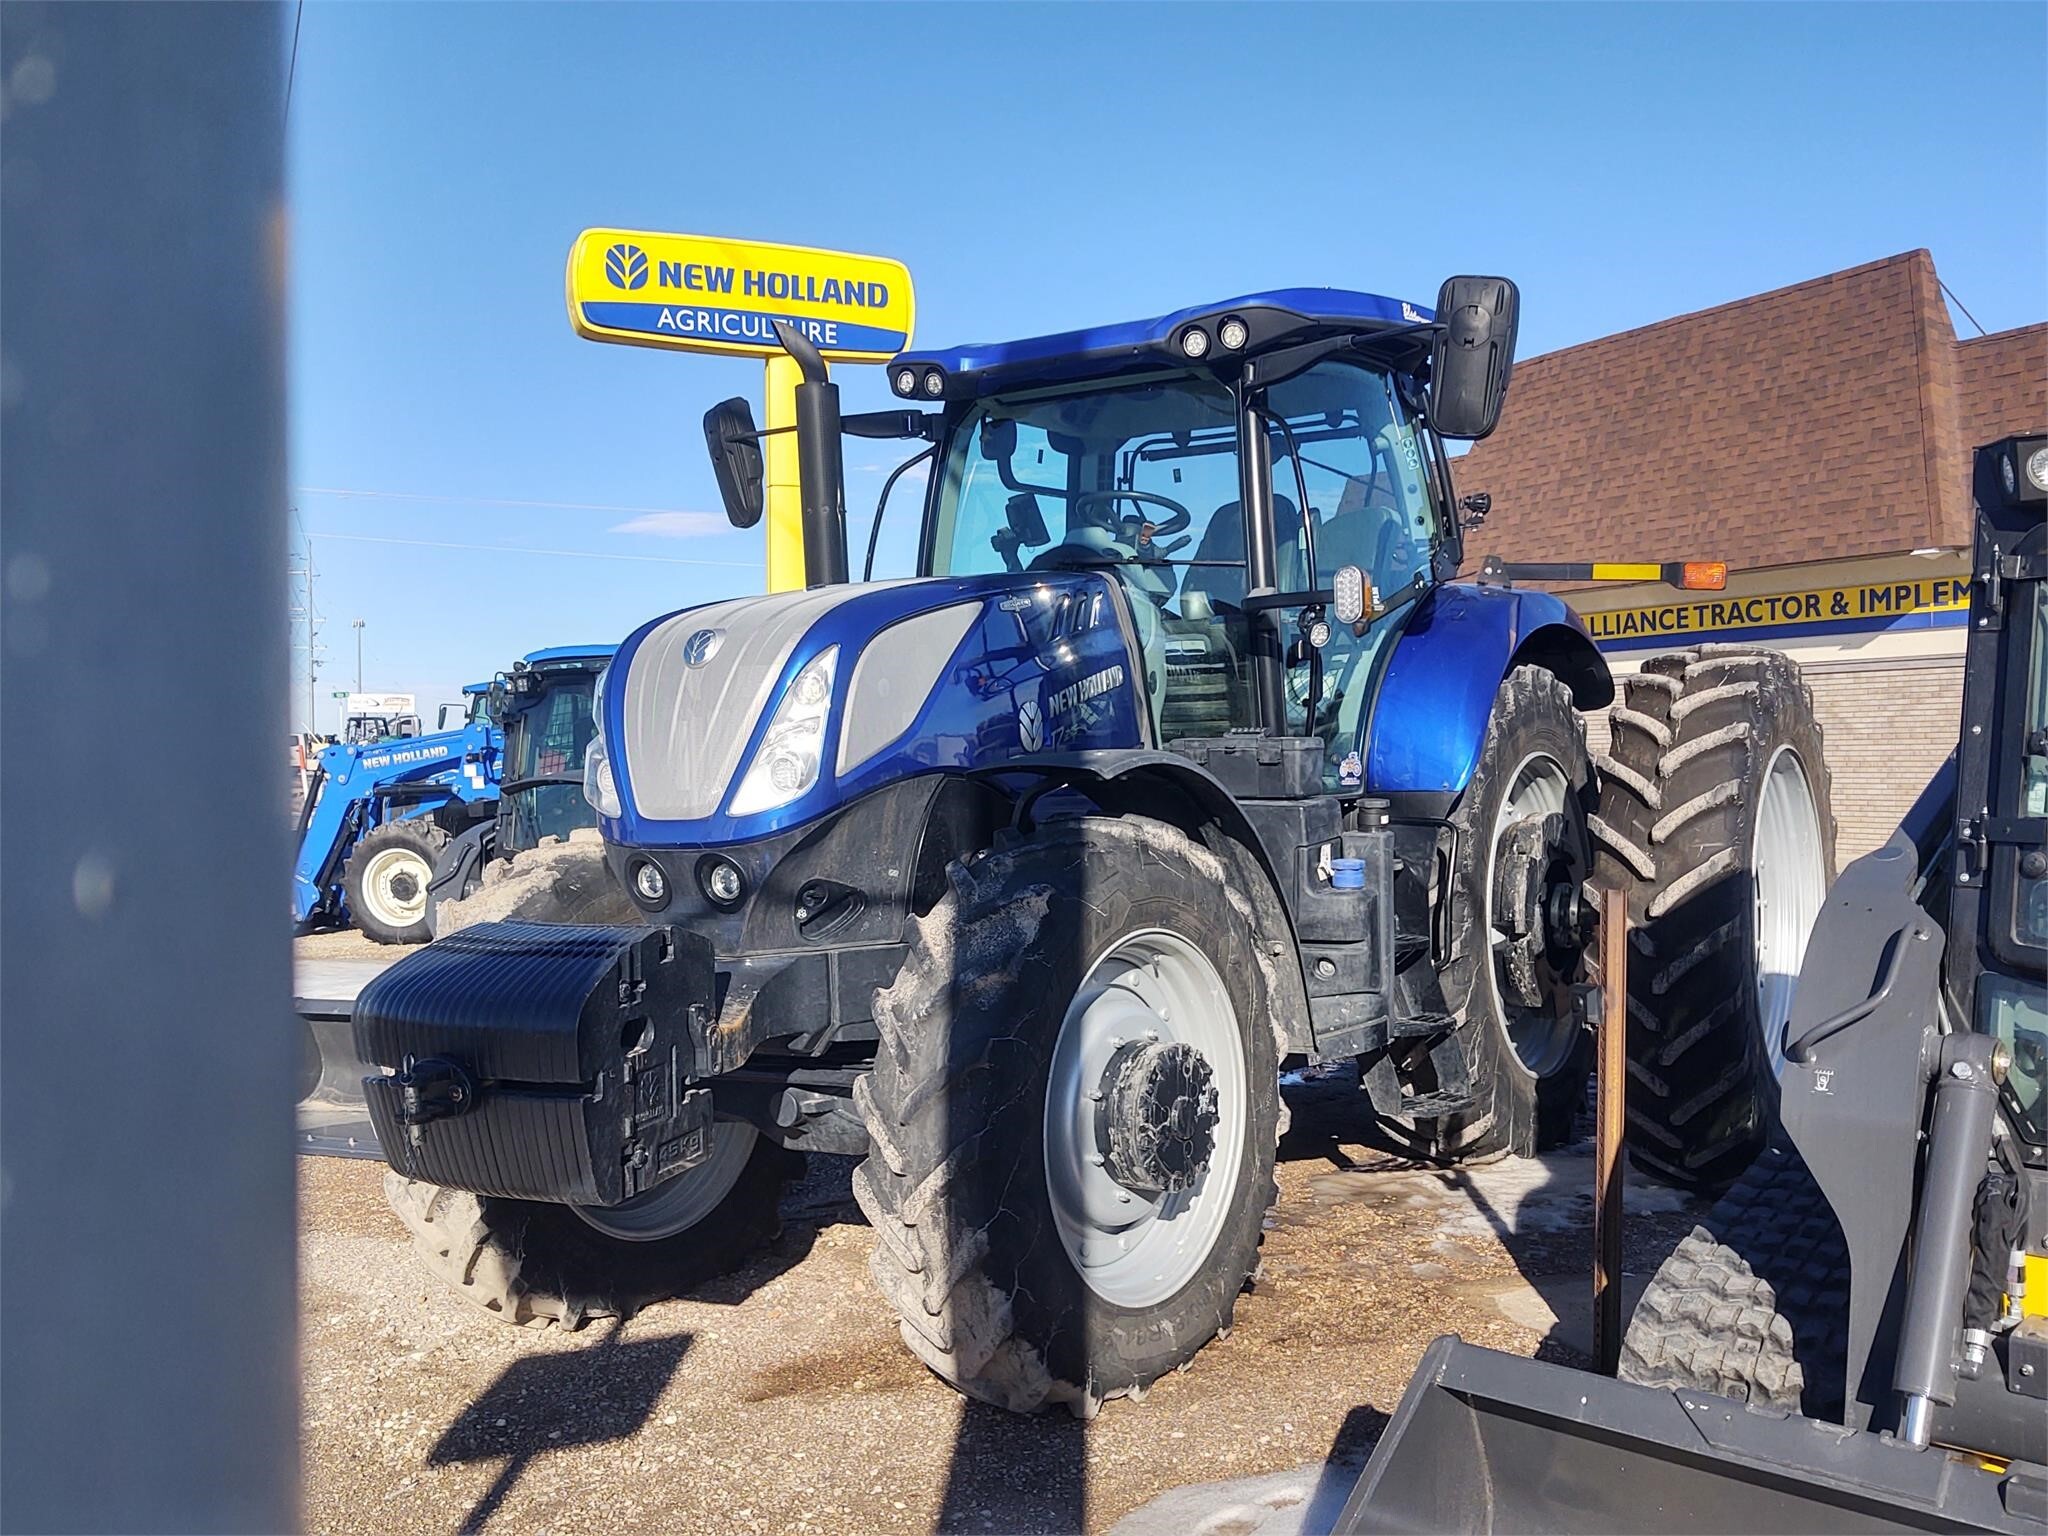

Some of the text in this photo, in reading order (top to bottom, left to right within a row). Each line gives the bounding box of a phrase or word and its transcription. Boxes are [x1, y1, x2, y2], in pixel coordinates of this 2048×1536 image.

[658, 260, 889, 309] NEW HOLLAND
[656, 308, 838, 344] AGRICULRE
[1582, 607, 1690, 637] LLIANCE
[1693, 595, 1821, 626] TRACTOR
[1830, 591, 1849, 616] &
[1049, 664, 1124, 718] NEW HOLLAND
[363, 746, 448, 769] NEW HOLLAND
